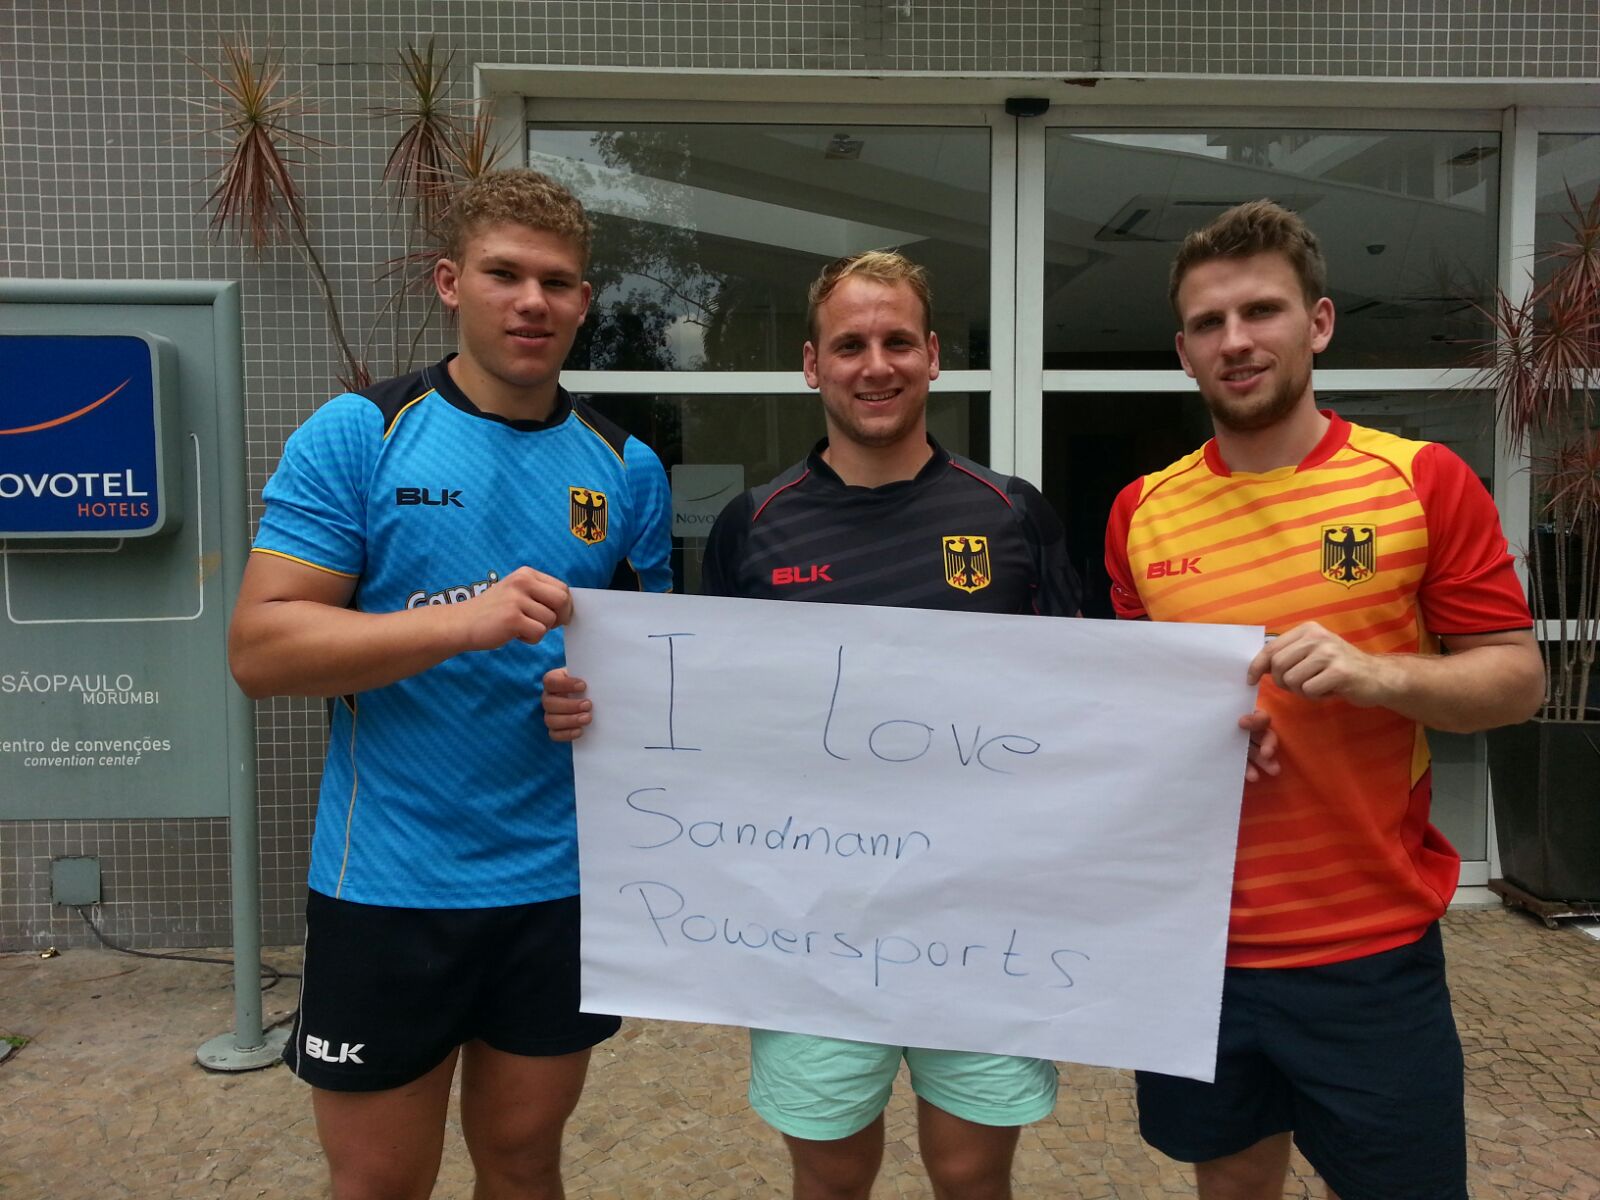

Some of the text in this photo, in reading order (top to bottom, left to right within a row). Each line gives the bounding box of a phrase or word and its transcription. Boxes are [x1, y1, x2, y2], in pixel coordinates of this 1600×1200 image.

[395, 487, 465, 508] BLK
[78, 502, 150, 517] HOTELS
[771, 564, 833, 586] BLK
[1146, 557, 1202, 580] BLK
[82, 691, 159, 704] MORUMBI
[644, 633, 702, 751] I
[0, 736, 171, 755] entro de convenções
[24, 754, 141, 767] convention center
[625, 787, 930, 860] Sandmann
[619, 881, 1091, 988] Powersports
[299, 1034, 365, 1064] BLK
